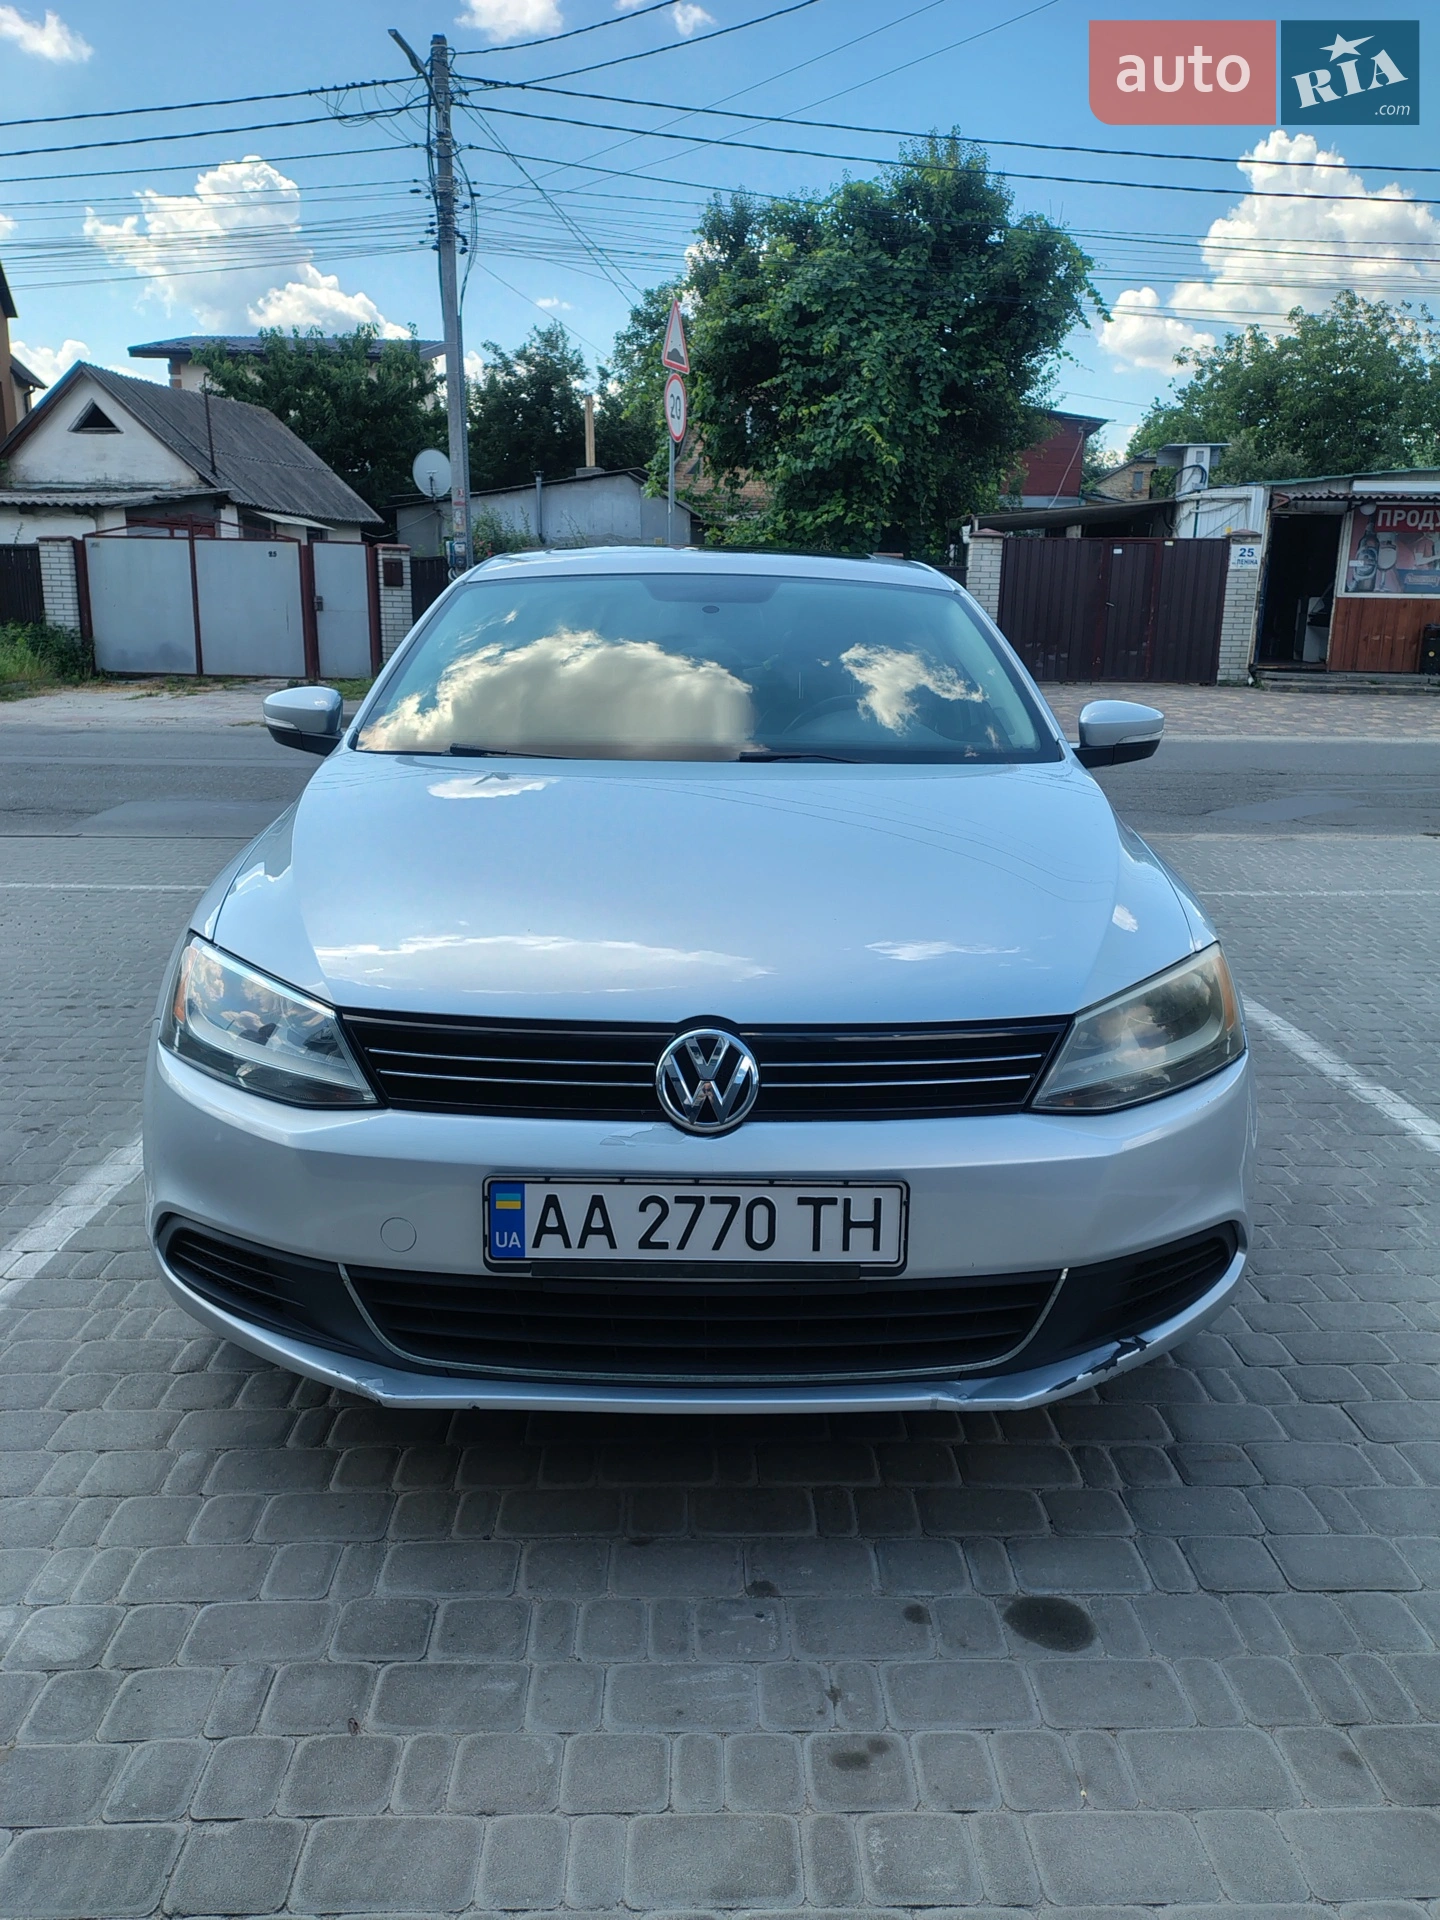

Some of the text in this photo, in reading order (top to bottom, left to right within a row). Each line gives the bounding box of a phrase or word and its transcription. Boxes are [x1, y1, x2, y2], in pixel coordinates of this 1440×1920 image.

[670, 394, 681, 420] 20
[1239, 548, 1255, 557] 25
[531, 1194, 882, 1252] AA 2770 TH
[495, 1232, 522, 1249] UA
